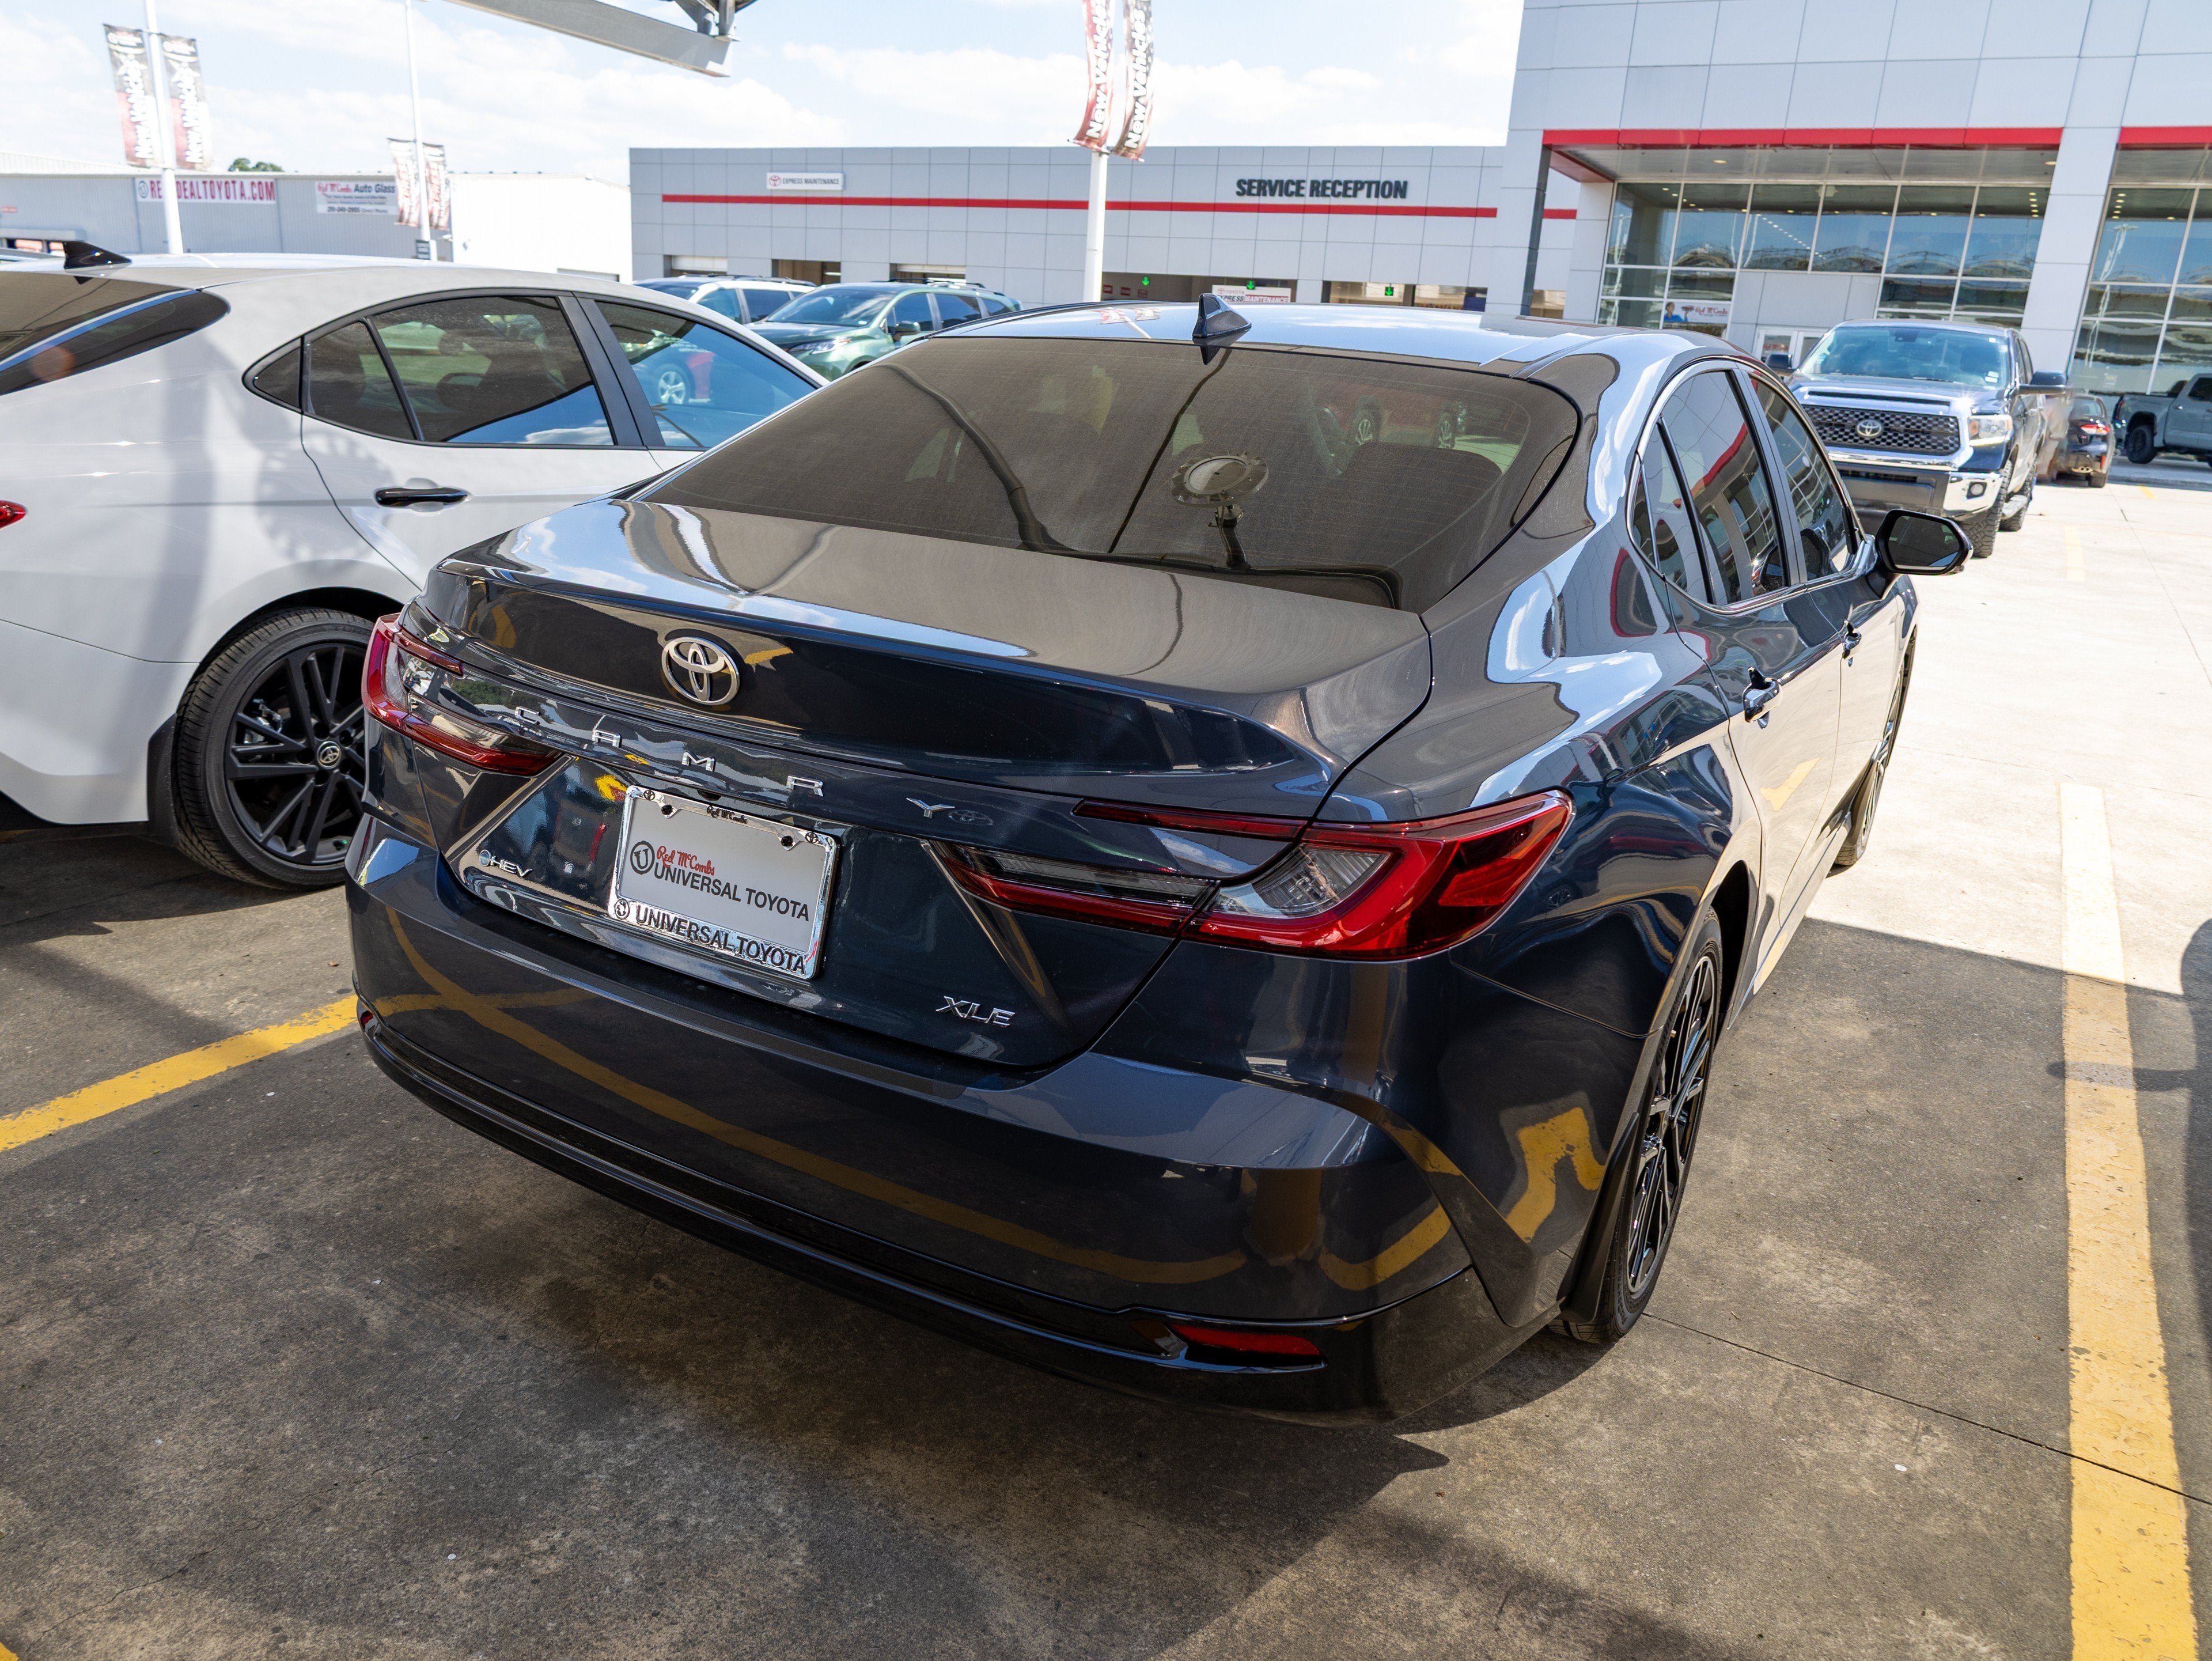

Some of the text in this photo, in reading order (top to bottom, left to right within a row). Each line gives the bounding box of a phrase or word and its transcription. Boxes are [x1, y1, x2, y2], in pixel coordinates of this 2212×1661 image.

[1124, 7, 1147, 149] New Vehicles
[1086, 88, 1107, 138] New
[134, 123, 154, 159] New
[185, 128, 203, 163] New
[150, 180, 275, 201] REDEALTOYOTA.COM
[354, 184, 372, 193] Auto
[374, 184, 395, 194] Glass
[1236, 179, 1408, 199] SERVICE RECEPTION
[706, 805, 719, 818] Red
[490, 855, 534, 877] HEV
[656, 845, 715, 876] Red McCombs
[654, 862, 809, 921] UNIVERSAL TOYOTA
[635, 903, 806, 975] UNIVERSAL TOYOTA
[935, 996, 1016, 1028] XLE
